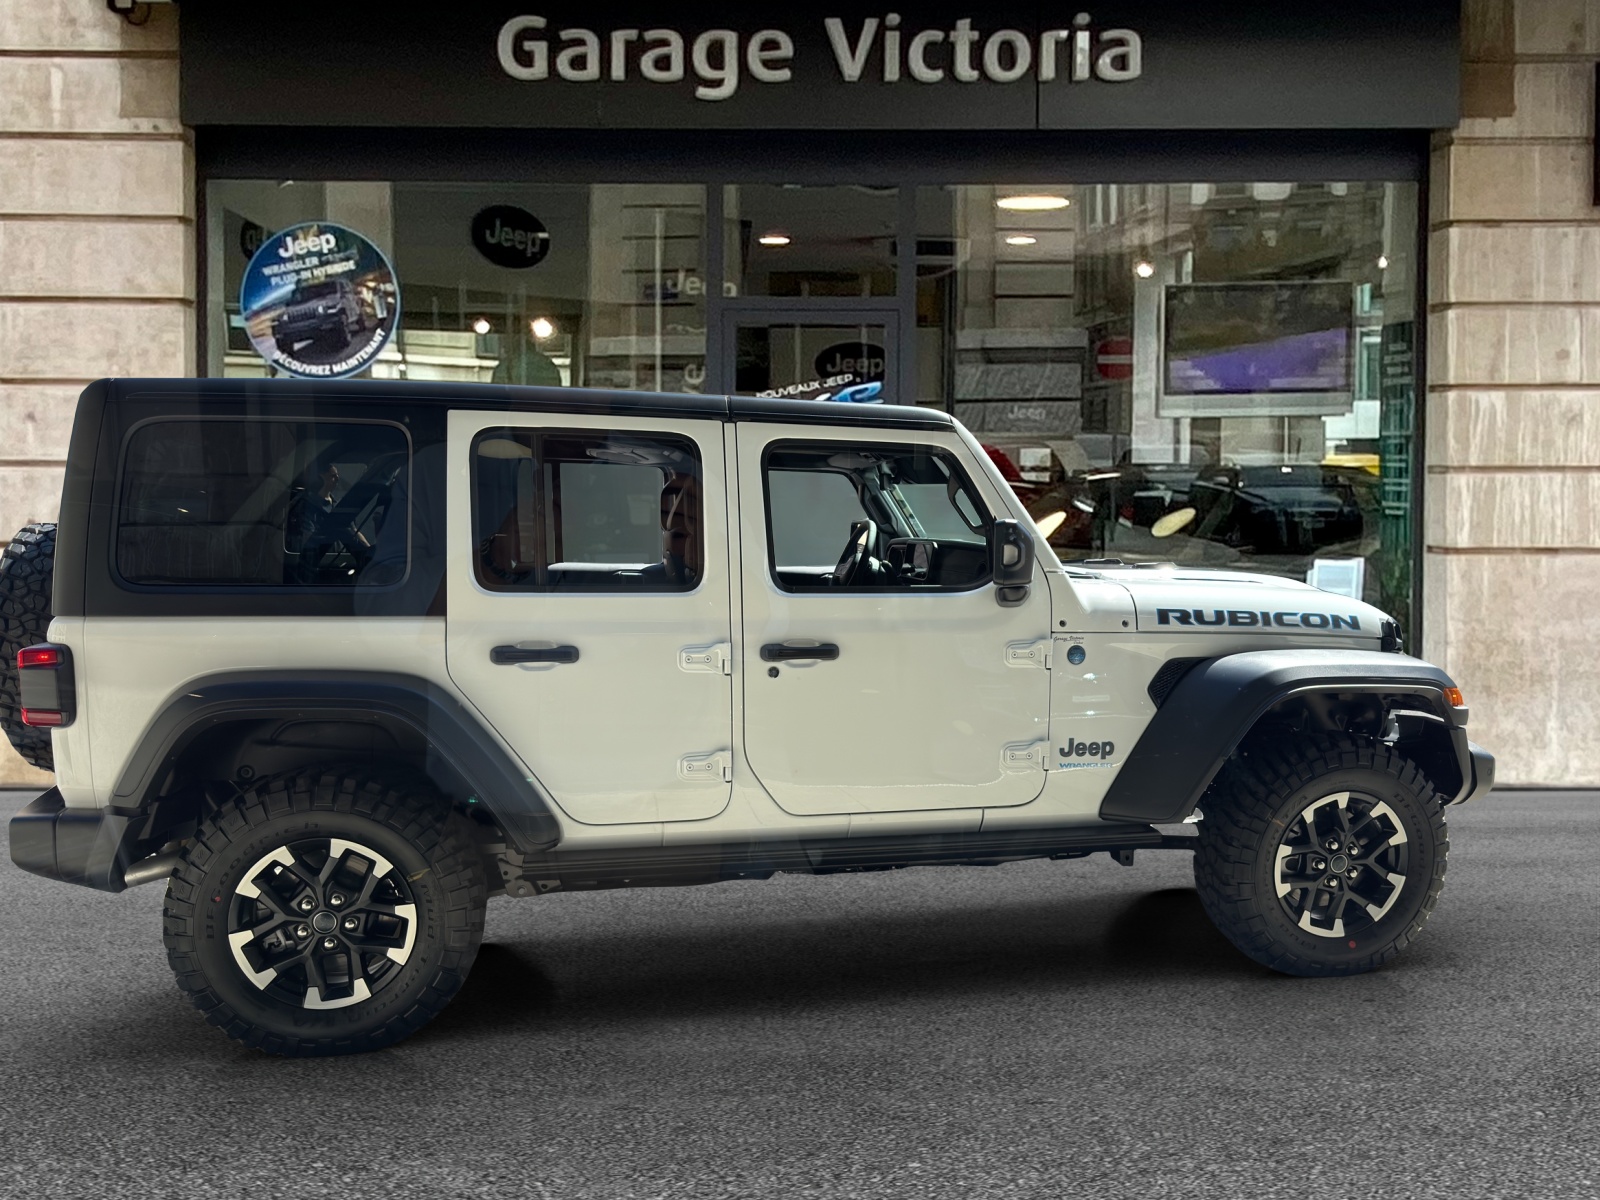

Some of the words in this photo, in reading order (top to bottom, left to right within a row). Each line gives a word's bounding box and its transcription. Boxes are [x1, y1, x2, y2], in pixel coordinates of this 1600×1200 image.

[497, 14, 794, 100] Garage
[824, 12, 1142, 82] Victoria
[278, 233, 337, 258] Jeep
[485, 218, 540, 257] Jeep
[262, 256, 319, 276] WRANGLER
[270, 268, 312, 286] PLUG-IN
[332, 327, 386, 374] MAINTENANT
[827, 353, 884, 377] Jeep
[755, 380, 820, 398] NOUVEAUX
[823, 373, 853, 388] JEEP
[1156, 608, 1361, 631] RUBICON
[1059, 738, 1115, 760] Jeep
